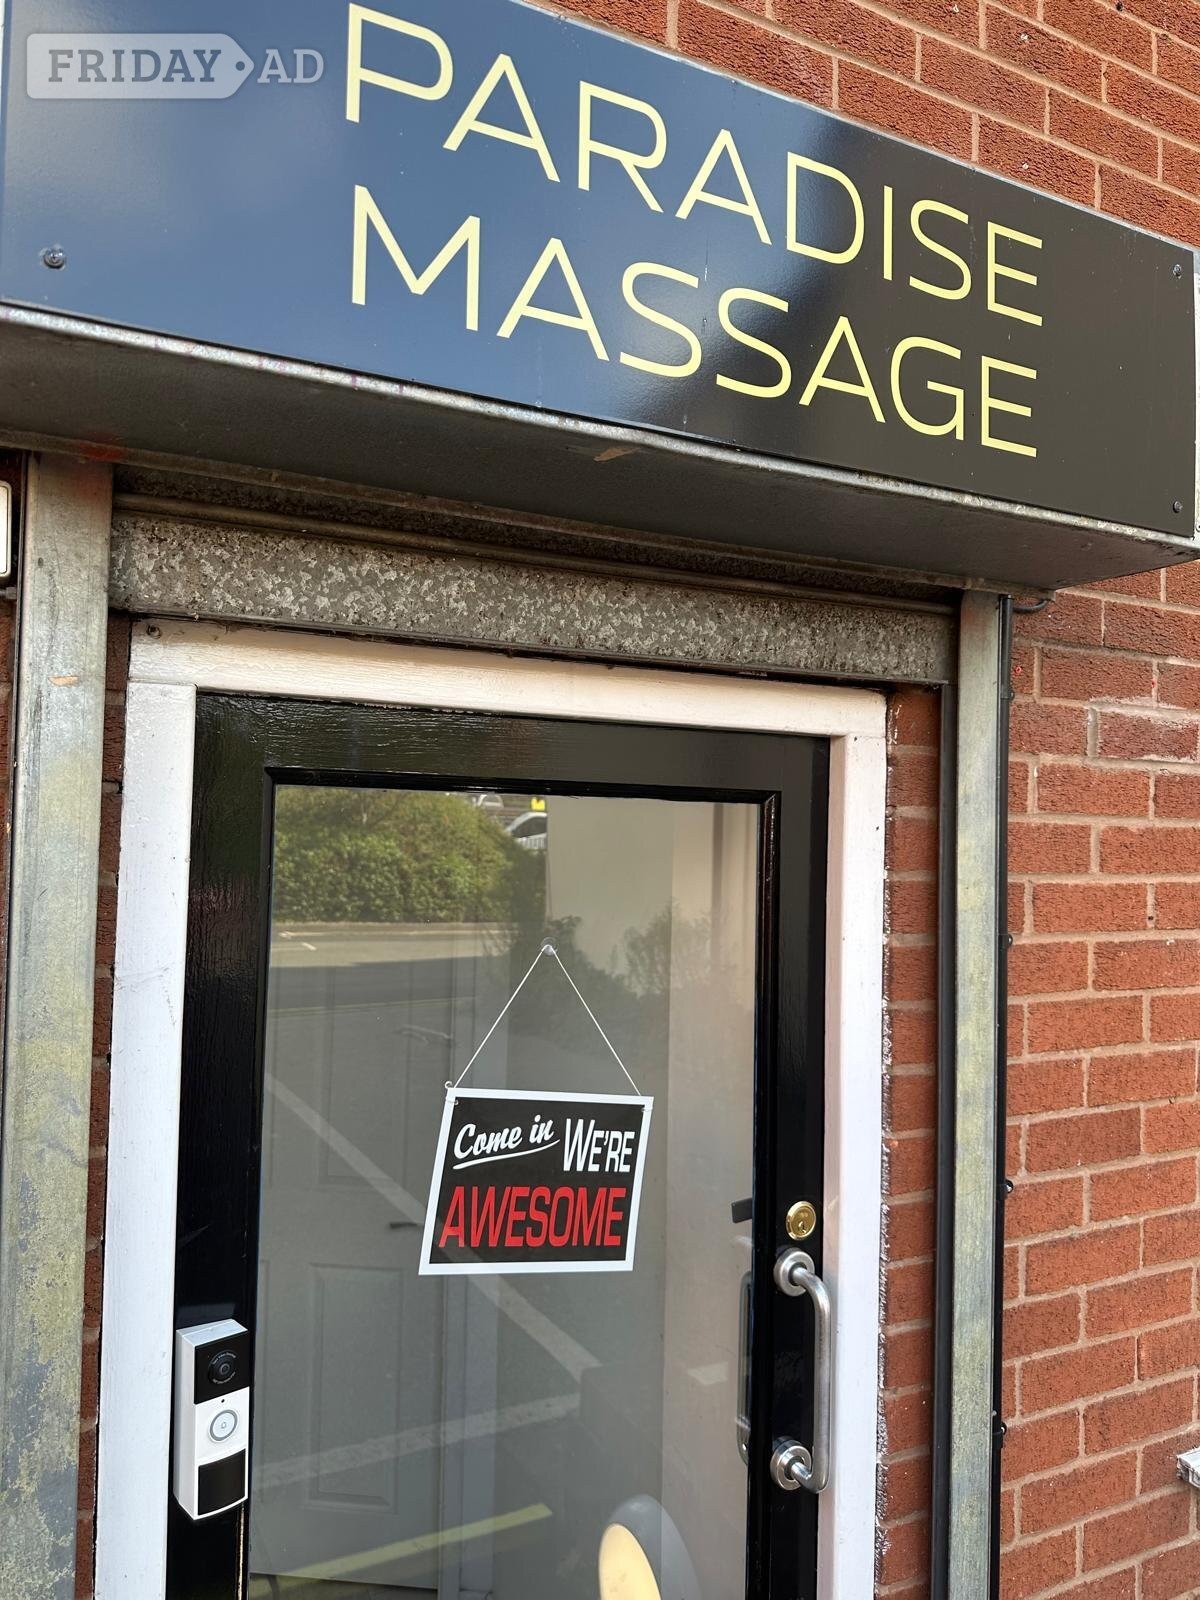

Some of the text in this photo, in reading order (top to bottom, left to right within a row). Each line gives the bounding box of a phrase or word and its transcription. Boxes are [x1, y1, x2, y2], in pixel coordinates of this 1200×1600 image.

[346, 3, 1043, 327] PARADISE
[351, 184, 1038, 457] MASSAGE
[438, 1185, 627, 1248] AWESOME
[453, 1123, 523, 1157] Come
[528, 1114, 555, 1144] in
